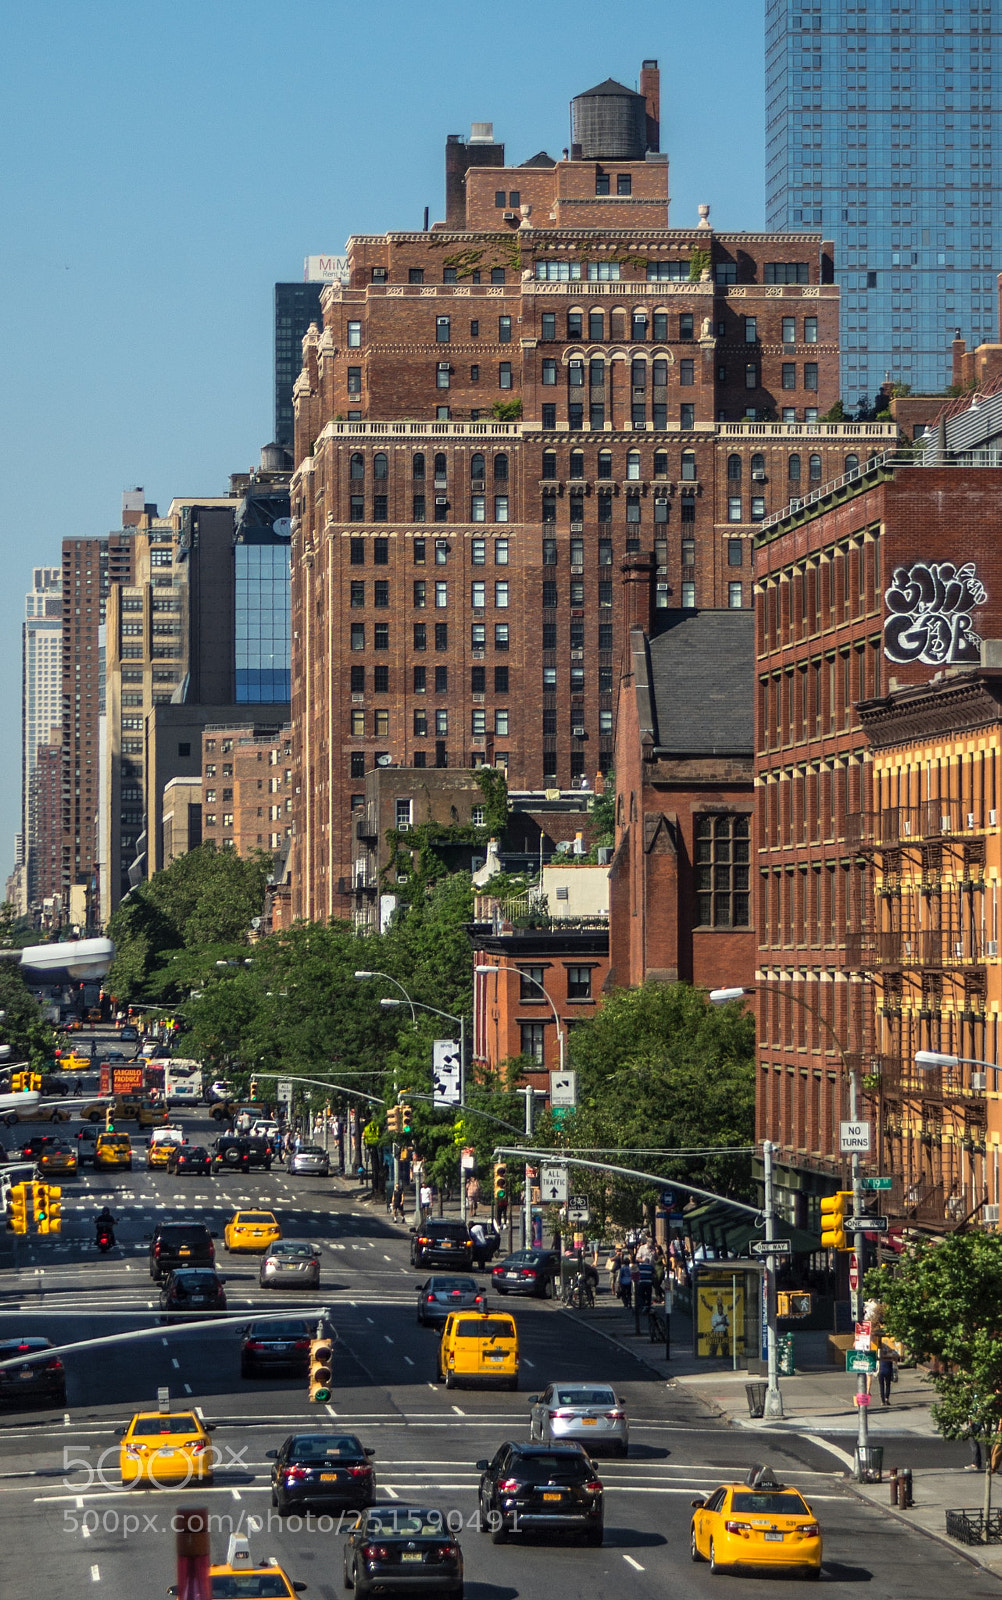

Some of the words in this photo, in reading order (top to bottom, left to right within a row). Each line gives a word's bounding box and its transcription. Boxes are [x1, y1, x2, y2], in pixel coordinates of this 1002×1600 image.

[114, 1075, 140, 1083] PRODUCE
[848, 1126, 861, 1135] NO
[842, 1138, 868, 1146] TURNS
[548, 1170, 561, 1178] ALL
[543, 1178, 566, 1186] TRAFFIC
[873, 1179, 881, 1188] 19
[757, 1243, 769, 1251] ONE
